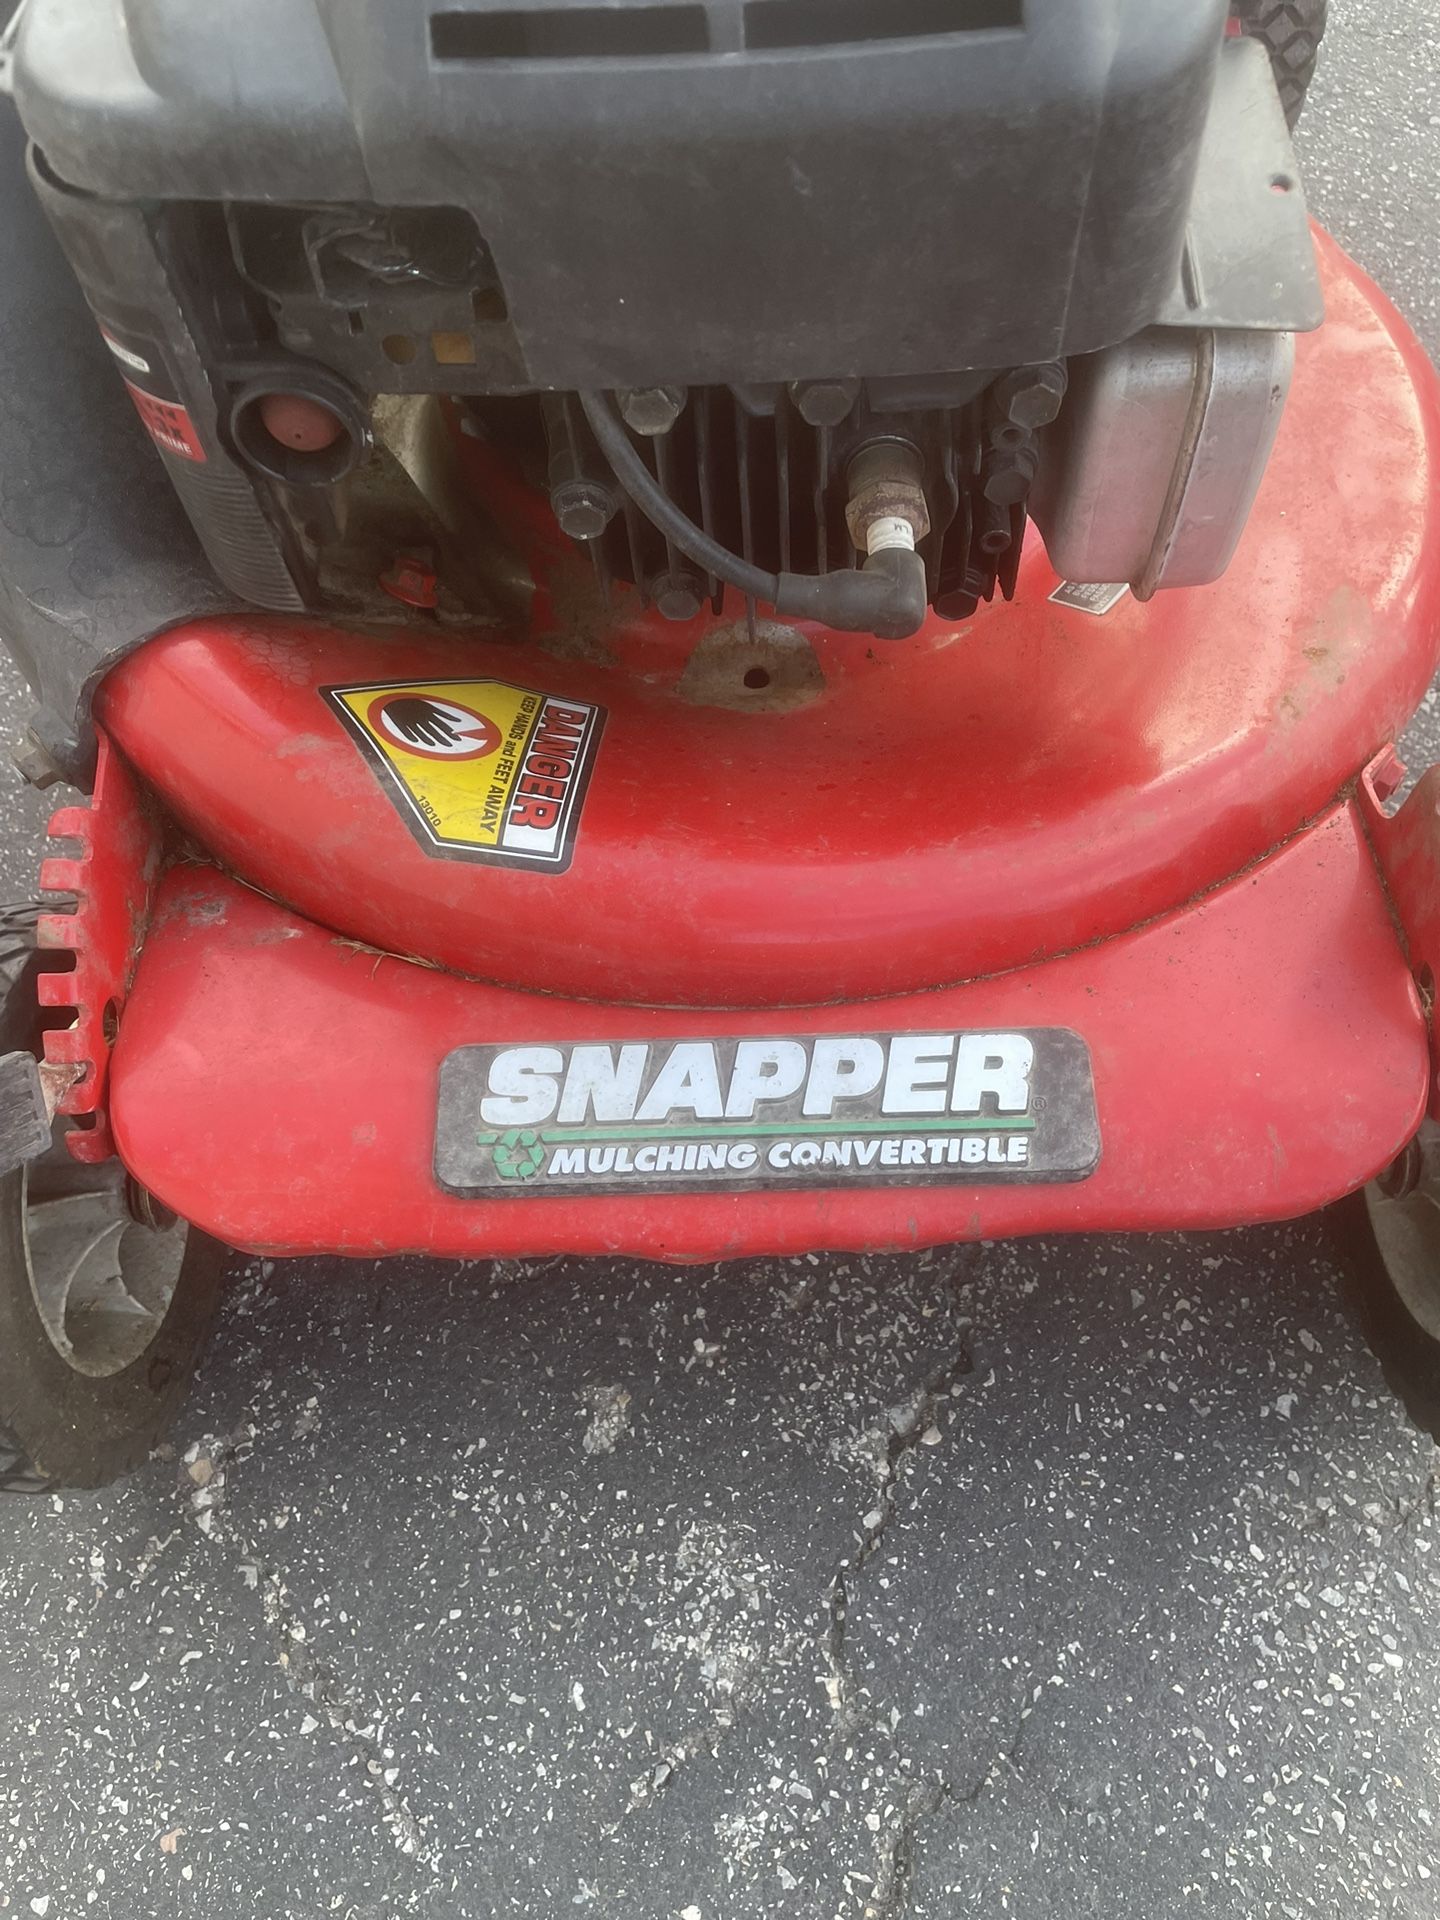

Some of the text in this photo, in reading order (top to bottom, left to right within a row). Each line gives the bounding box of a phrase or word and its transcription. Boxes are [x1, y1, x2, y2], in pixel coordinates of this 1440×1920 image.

[480, 695, 538, 833] KEEP HANDS and FEET AWAY
[508, 704, 588, 830] DANGER
[419, 795, 441, 826] 13010
[480, 1034, 1034, 1125] SNAPPER
[547, 1137, 1029, 1175] MULCHING CONVERTIBLE
